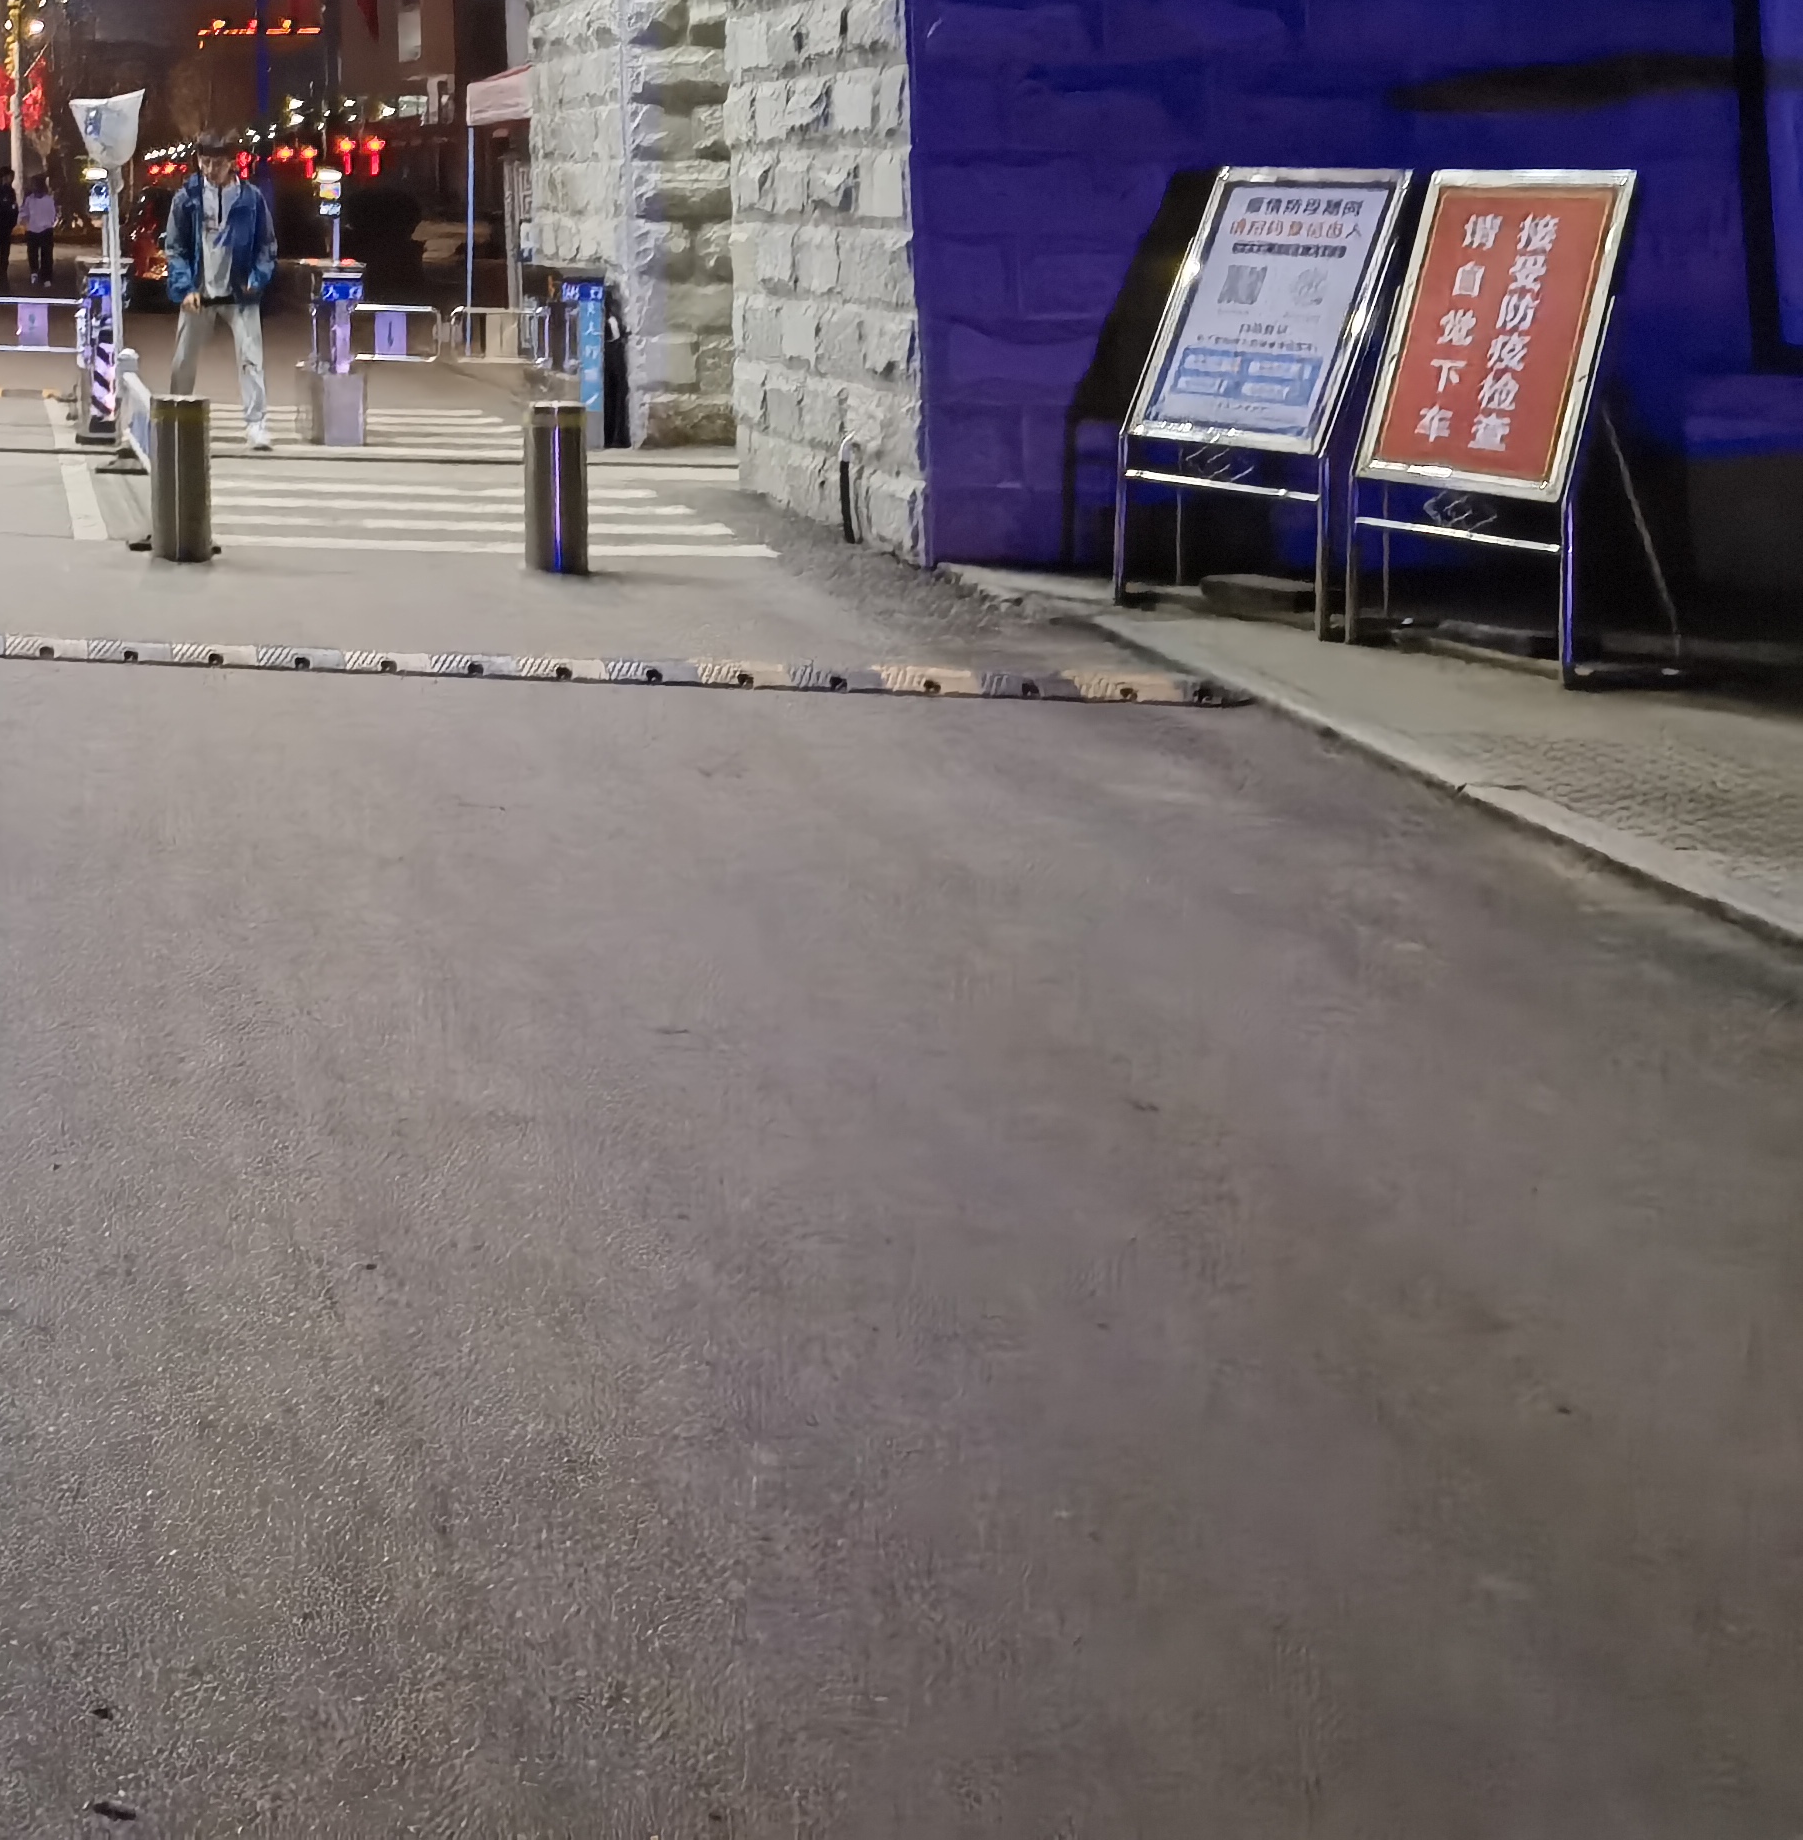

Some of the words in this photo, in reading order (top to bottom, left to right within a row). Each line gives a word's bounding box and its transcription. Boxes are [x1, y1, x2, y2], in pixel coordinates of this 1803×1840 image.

[1414, 213, 1503, 443] 请自觉下车
[1468, 212, 1560, 452] 接受防疫检查
